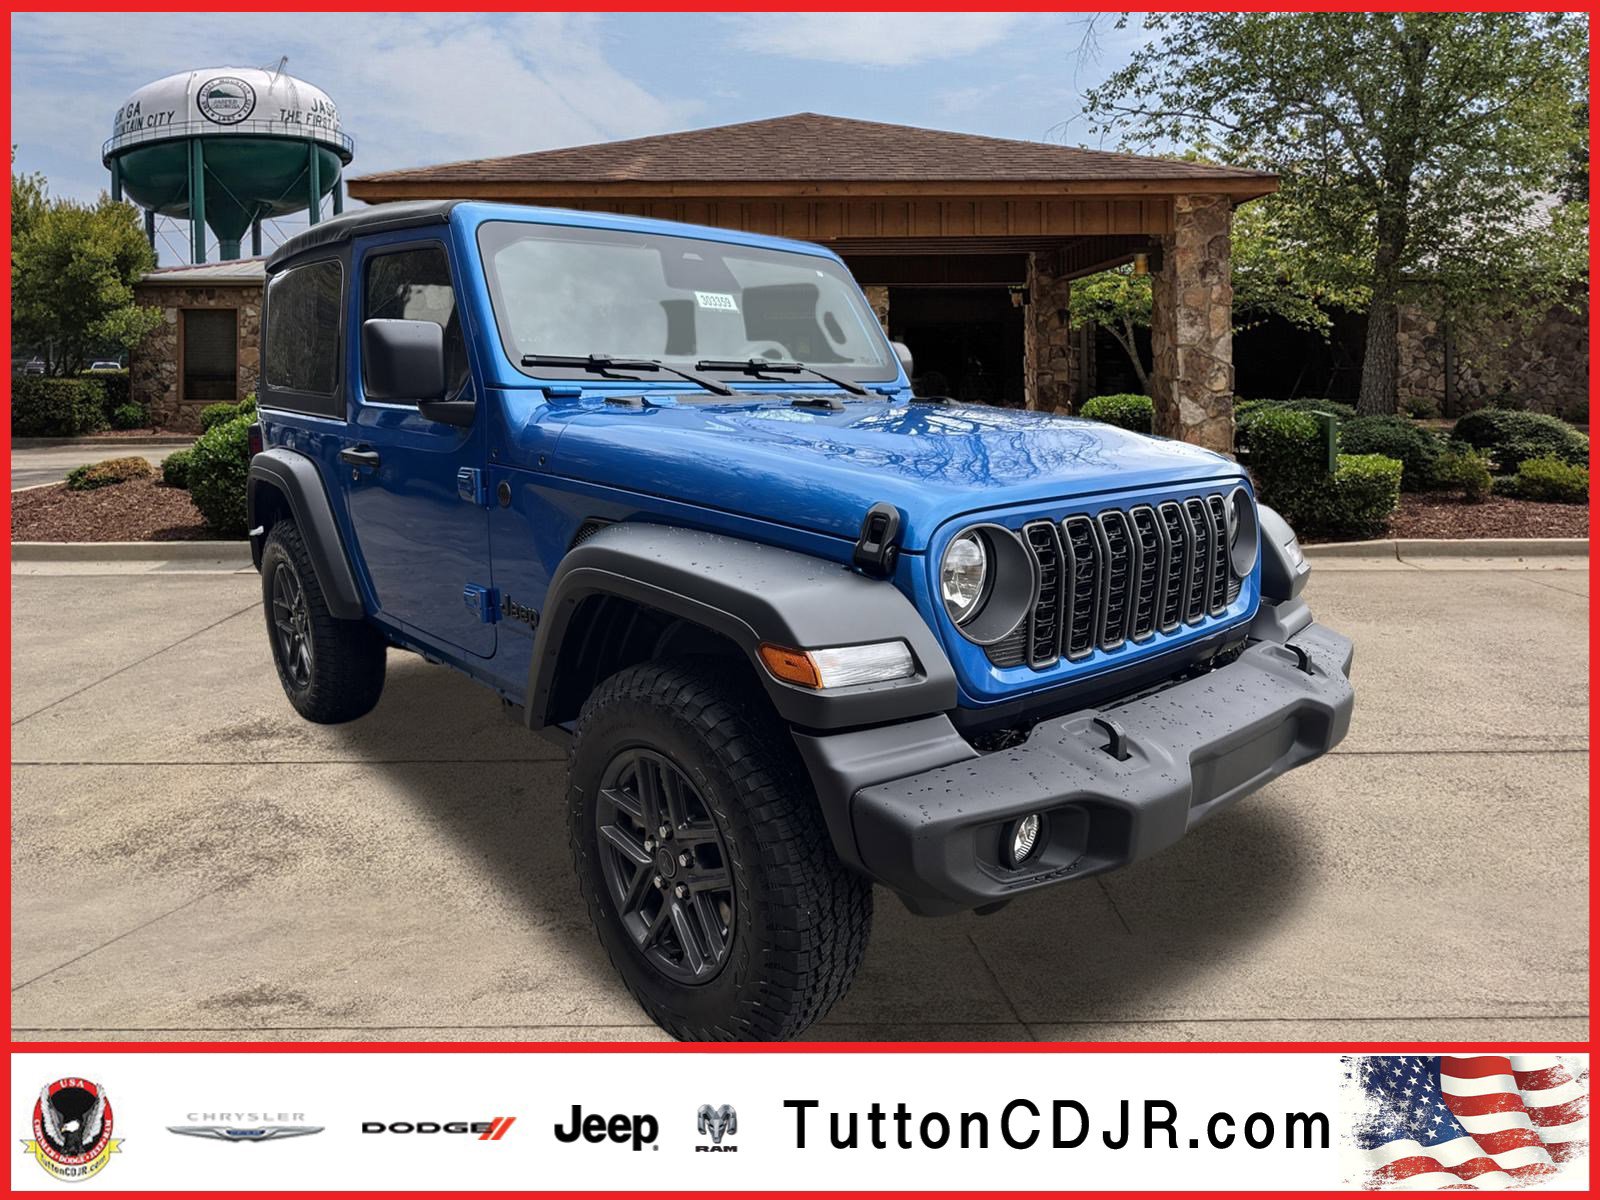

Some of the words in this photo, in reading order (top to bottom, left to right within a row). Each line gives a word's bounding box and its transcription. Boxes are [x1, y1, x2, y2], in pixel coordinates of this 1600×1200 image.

[126, 100, 141, 119] GA
[147, 110, 176, 128] CITY
[280, 108, 303, 124] THE
[306, 112, 332, 129] FIRST
[499, 593, 541, 631] Jeep
